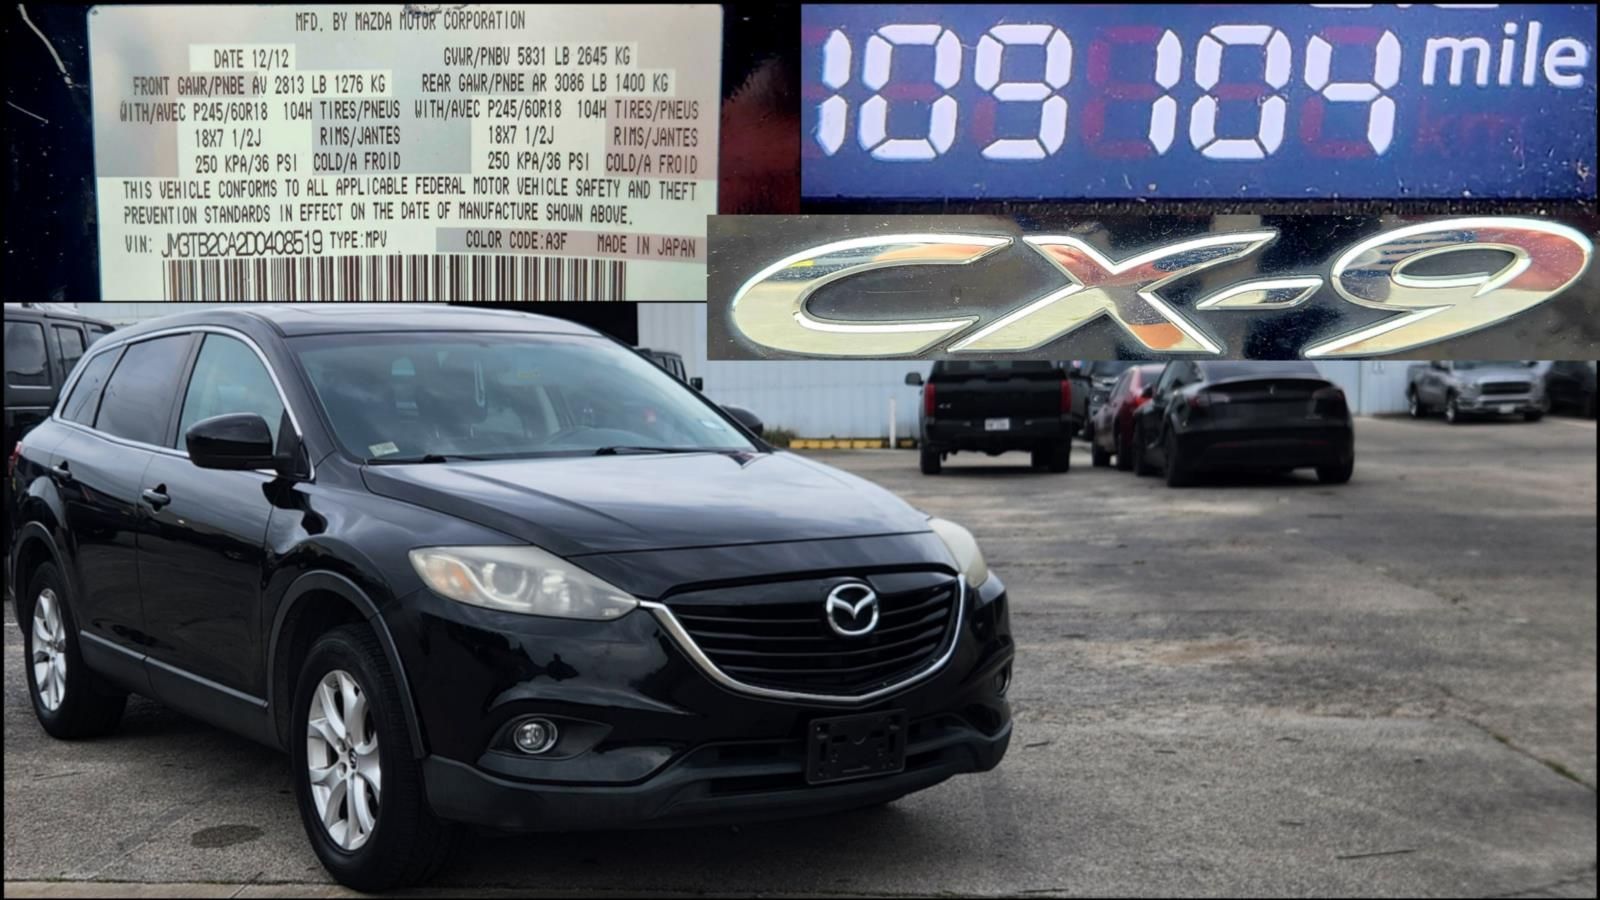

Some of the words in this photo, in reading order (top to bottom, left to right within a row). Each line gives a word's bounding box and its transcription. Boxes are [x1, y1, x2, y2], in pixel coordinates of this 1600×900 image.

[296, 12, 323, 31] MFD.
[333, 12, 347, 31] BY
[355, 12, 392, 30] MAZDA
[400, 11, 436, 29] MOTOR
[444, 11, 525, 29] CORPORATION
[214, 49, 244, 68] DATE
[252, 49, 288, 70] 12/12
[444, 47, 510, 67] GVWR/PNBV
[517, 47, 545, 65] 5831
[554, 47, 570, 65] LB
[577, 47, 607, 65] 2645
[615, 47, 630, 65] KG
[1422, 20, 1588, 87] mile
[133, 76, 170, 95] FRONT
[177, 76, 245, 98] GAWR/PNBE
[252, 76, 267, 95] AV
[275, 75, 304, 94] 2813
[312, 75, 326, 93] LB
[334, 75, 363, 93] 1276
[371, 74, 385, 92] KG
[422, 74, 451, 92] REAR
[458, 74, 525, 94] GAWR/PNBE
[532, 74, 547, 92] AR
[554, 74, 584, 92] 3086
[592, 74, 607, 92] LB
[615, 74, 645, 92] 1400
[653, 73, 668, 92] KG
[119, 103, 186, 124] WITH/AVEC
[193, 102, 268, 124] P245/60R18
[283, 101, 312, 119] 104H
[320, 100, 400, 121] TIRES/PNEUS
[414, 100, 481, 120] WITH/AVEC
[488, 100, 562, 120] P245/60R18
[577, 100, 607, 118] 104H
[615, 100, 699, 121] TIRES/PNEUS
[195, 129, 224, 147] 18X7
[232, 128, 262, 149] 1/2J
[320, 126, 400, 146] RIMS/JANTES
[488, 126, 517, 144] 18X7
[525, 126, 555, 146] 1/2J
[614, 126, 698, 148] RIMS/JANTES
[196, 155, 218, 173] 250
[225, 154, 269, 174] KPA/36
[277, 154, 297, 171] PSI
[313, 152, 357, 173] COLD/A
[364, 152, 401, 170] FROID
[488, 151, 510, 170] 250
[517, 152, 561, 172] KPA/36
[568, 152, 589, 170] PSI
[606, 153, 652, 174] COLD/A
[659, 154, 698, 174] FROID
[123, 181, 152, 199] THIS
[160, 180, 211, 198] VEHICLE
[218, 179, 277, 197] CONFORMS
[285, 178, 299, 197] TO
[307, 178, 328, 196] ALL
[336, 177, 408, 195] APPLICABLE
[415, 177, 466, 195] FEDERAL
[473, 177, 510, 195] MOTOR
[517, 177, 568, 197] VEHICLE
[576, 178, 621, 198] SAFETY
[628, 180, 651, 198] AND
[659, 181, 697, 201] THEFT
[124, 206, 197, 224] PREVENTION
[204, 204, 271, 223] STANDARDS
[279, 204, 292, 222] IN
[300, 203, 343, 221] EFFECT
[350, 202, 365, 220] ON
[373, 202, 394, 220] THE
[401, 201, 430, 219] DATE
[437, 201, 451, 219] OF
[459, 201, 539, 221] MANUFACTURE
[546, 203, 583, 222] SHOWN
[590, 205, 633, 225] ABOVE.
[125, 235, 152, 253] VIN:
[330, 231, 388, 249] TYPE:MPV
[466, 230, 502, 248] COLOR
[510, 231, 567, 250] CODE:A3F
[597, 234, 627, 253] MADE
[636, 236, 649, 255] IN
[657, 237, 695, 258] JAPAN
[730, 216, 1594, 357] CX-9
